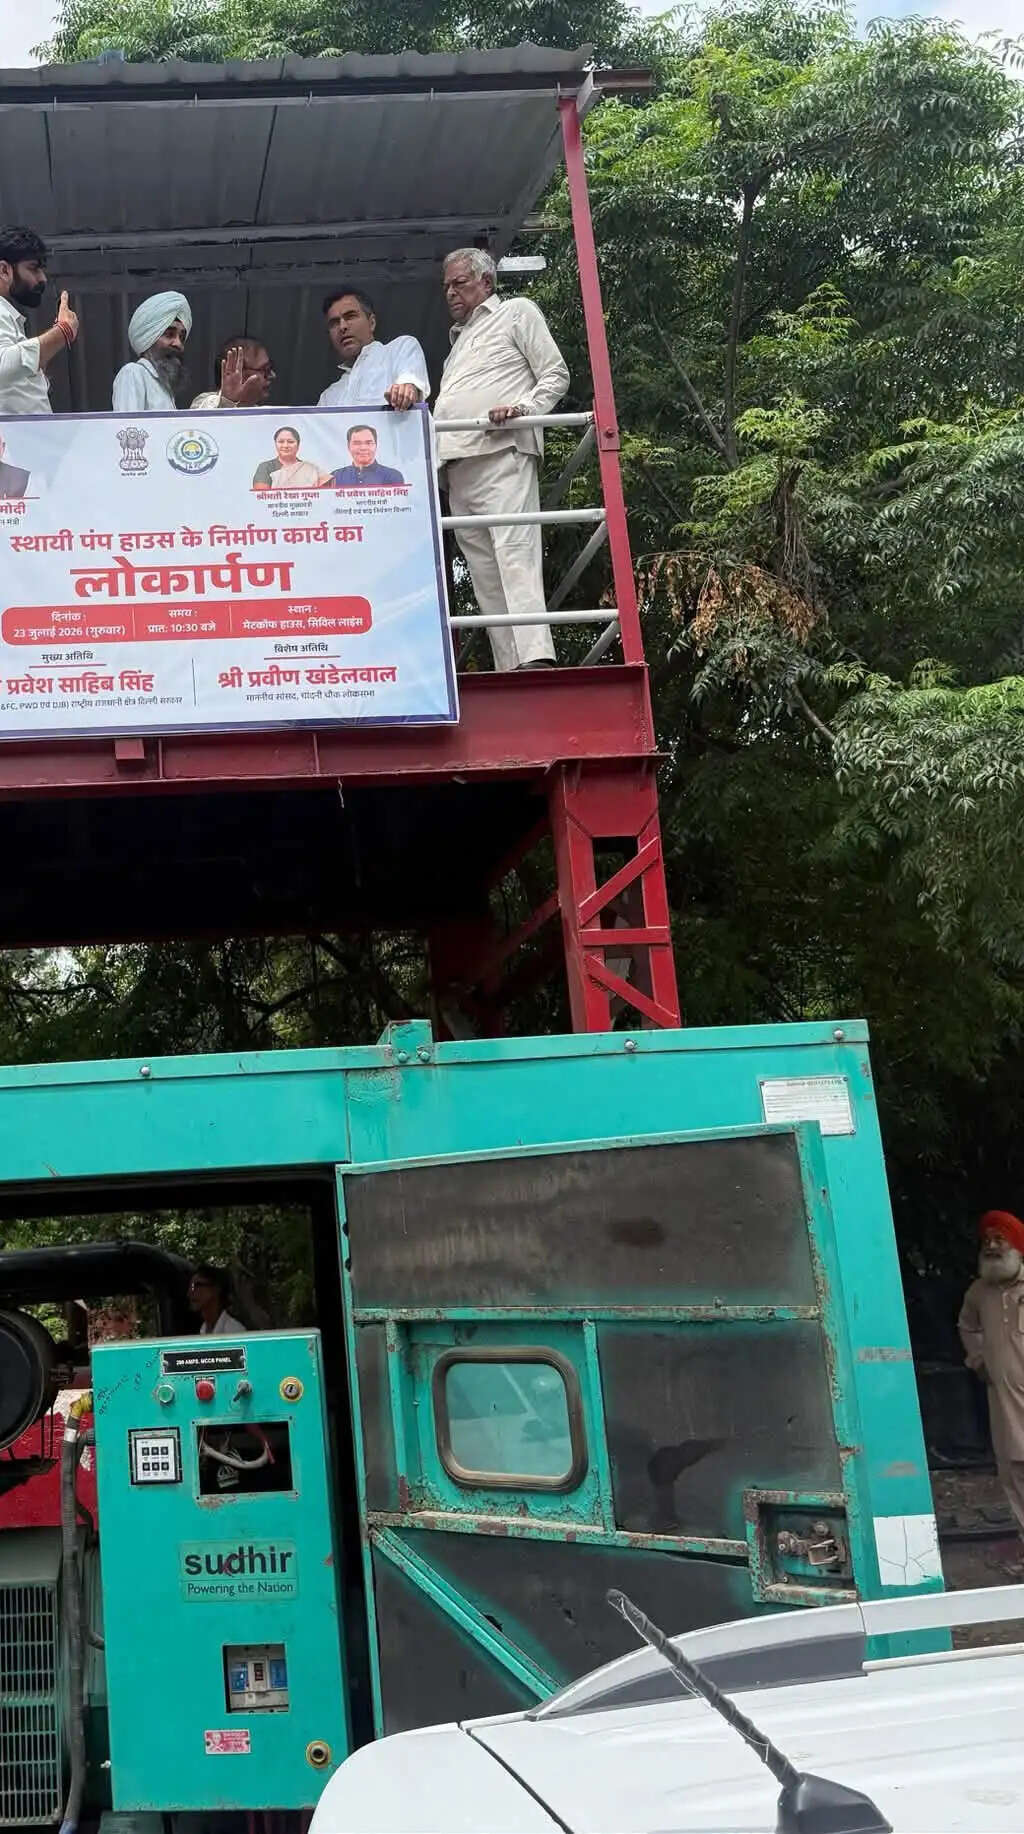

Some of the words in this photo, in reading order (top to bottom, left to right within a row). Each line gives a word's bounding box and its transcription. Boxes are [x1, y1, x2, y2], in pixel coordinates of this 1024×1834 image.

[10, 528, 73, 552] स्थायी
[80, 528, 113, 550] पंप
[118, 532, 175, 552] हाउस
[180, 526, 203, 548] के
[208, 524, 278, 546] निर्माण
[282, 521, 329, 544] कार्य
[333, 525, 364, 542] का
[70, 552, 294, 598] लोकार्पण
[170, 623, 198, 632] 10:30
[200, 620, 216, 632] बजे
[280, 618, 306, 630] हाउस,
[308, 616, 336, 628] सिविल
[14, 628, 26, 638] 23
[28, 625, 56, 640] जुलाई
[58, 628, 83, 638] 2026
[86, 625, 126, 639] (गुरुवार)
[274, 642, 298, 654] विशेष
[300, 642, 328, 652] अतिथि
[40, 652, 62, 664] मुख्य
[64, 650, 94, 661] अतिथि
[6, 674, 54, 695] प्रवेश
[58, 672, 114, 694] साहिब
[118, 670, 154, 692] सिंह
[218, 666, 243, 688] श्री
[248, 664, 300, 688] प्रवीण
[304, 664, 398, 685] खंडेलवाल
[19, 702, 38, 710] PWD
[185, 1546, 293, 1576] sudhir
[187, 1583, 235, 1597] Powering
[238, 1582, 255, 1593] the
[258, 1582, 293, 1593] Nation
